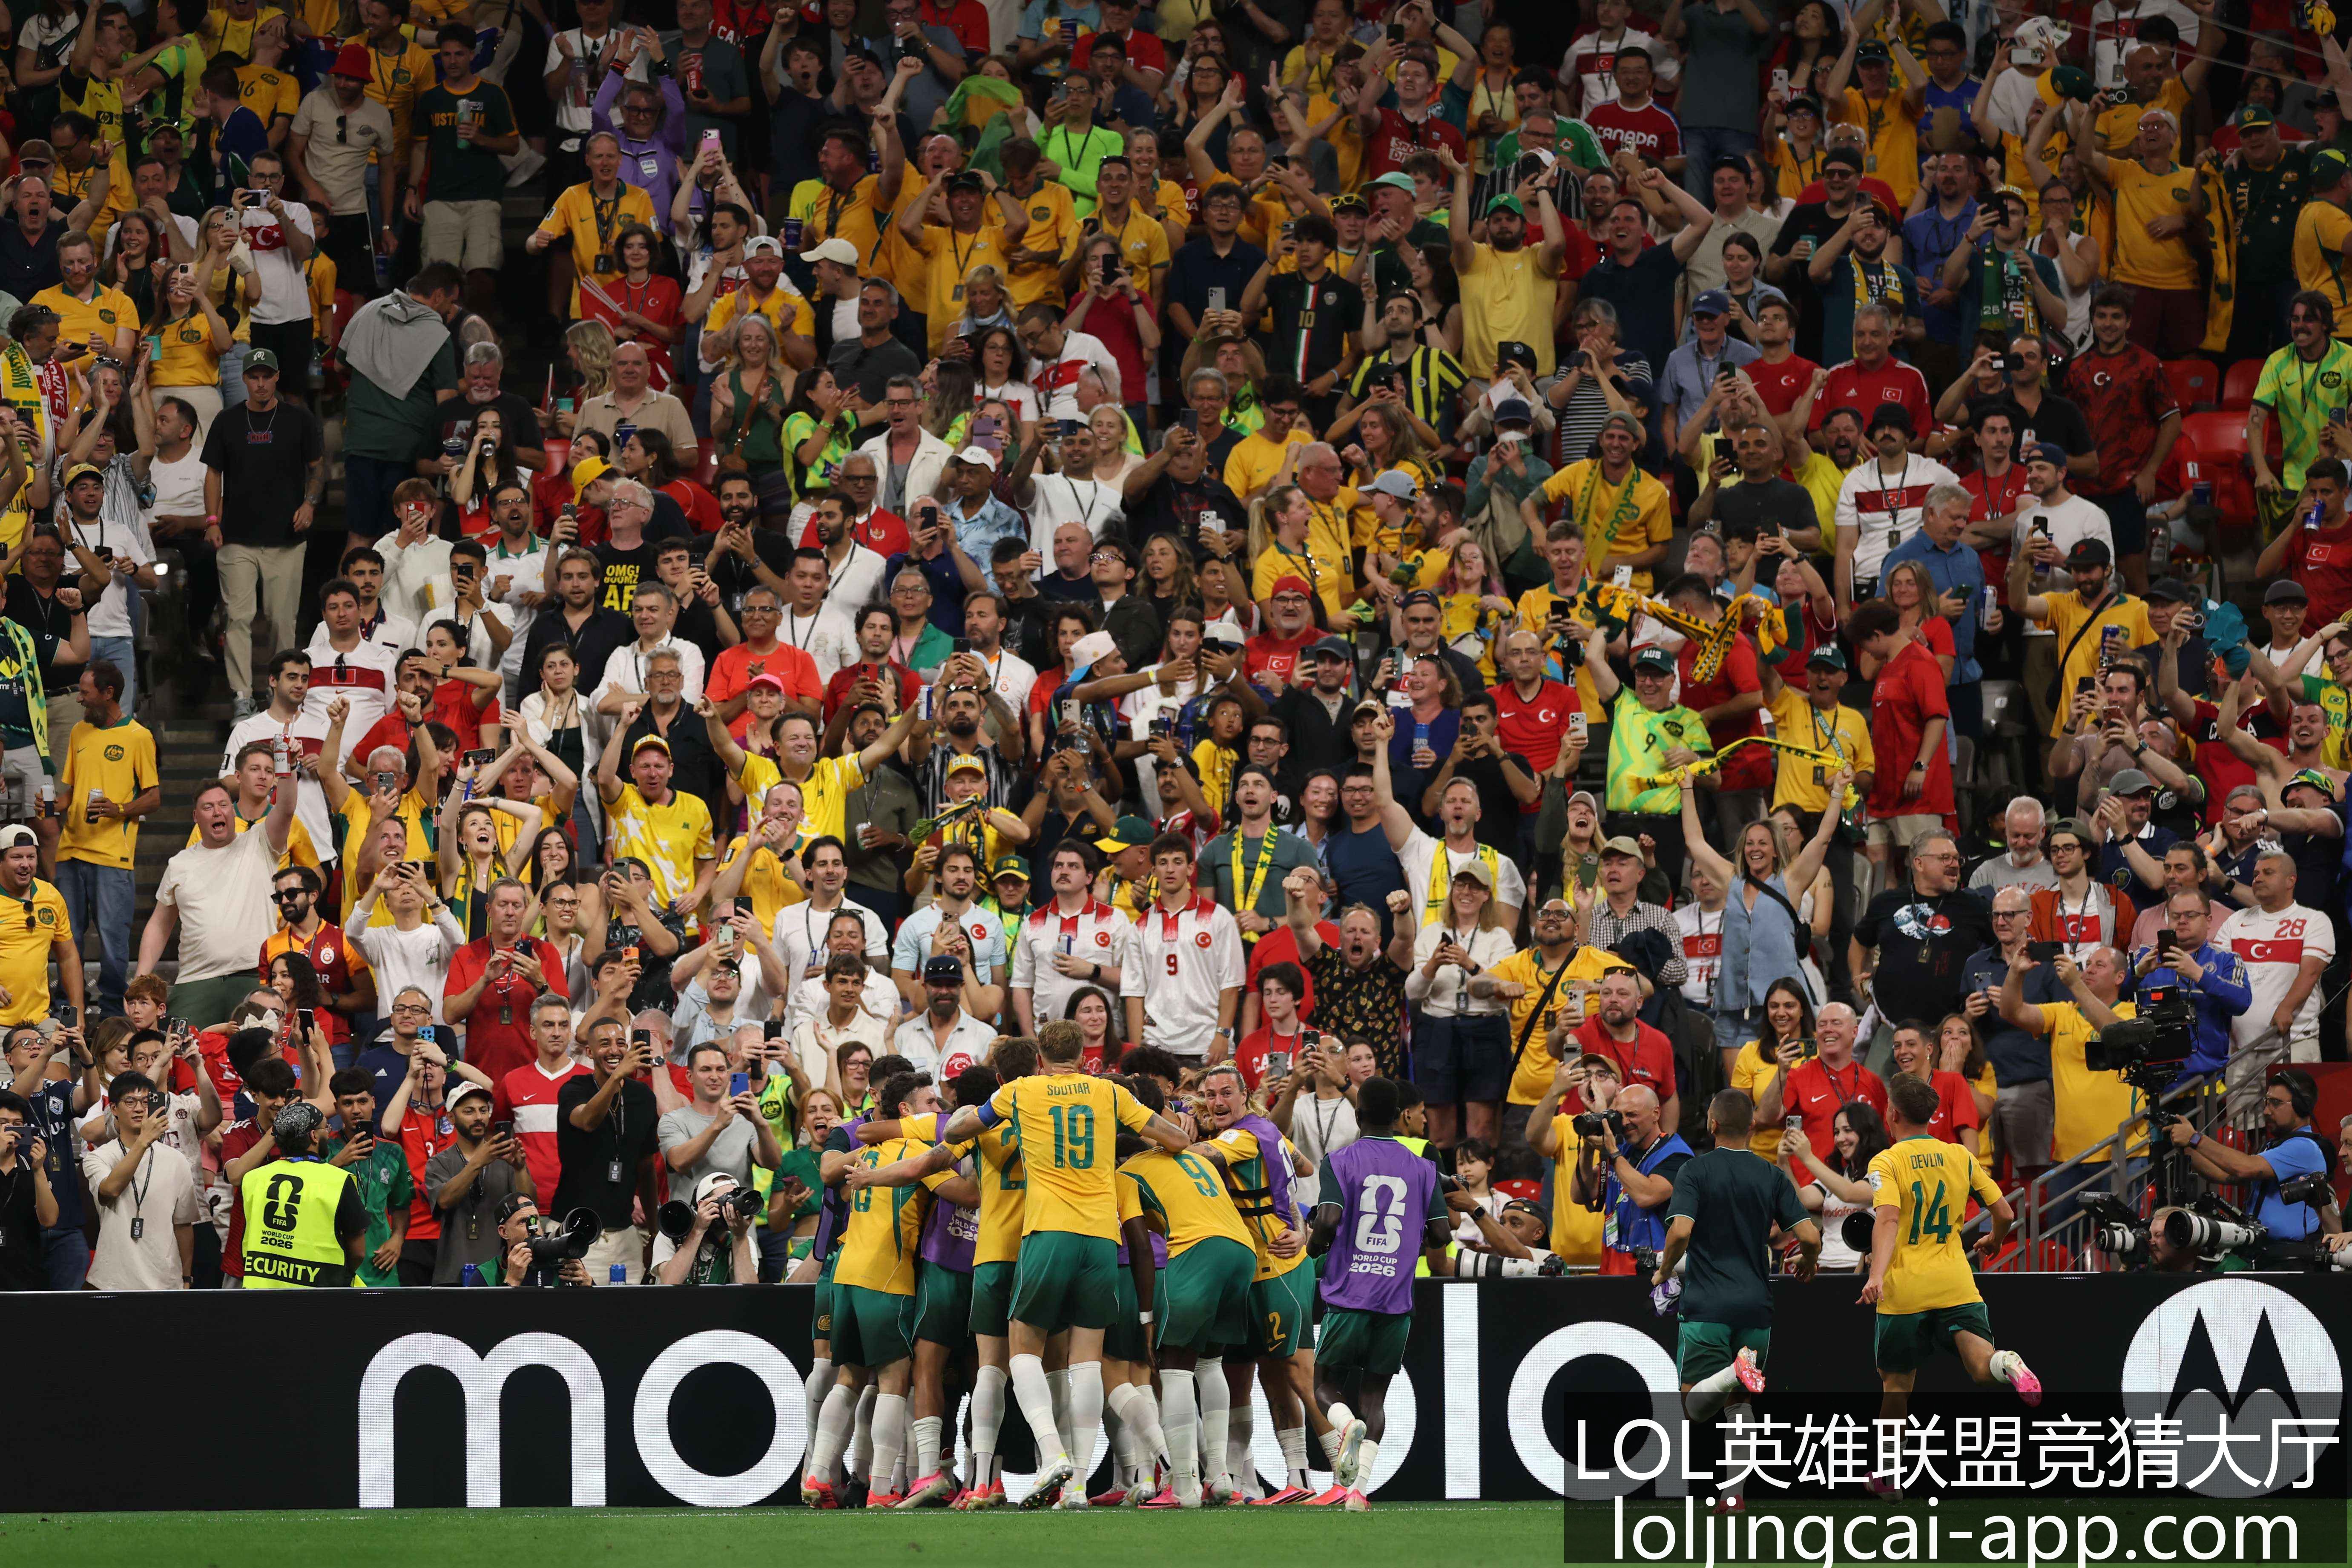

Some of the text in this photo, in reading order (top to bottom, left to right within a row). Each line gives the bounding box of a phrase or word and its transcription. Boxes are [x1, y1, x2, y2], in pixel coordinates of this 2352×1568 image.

[1597, 126, 1658, 148] CANADA
[1298, 310, 1316, 327] 10
[606, 565, 640, 576] OMG!
[1642, 649, 1662, 659] AUS
[1813, 646, 1833, 656] AUS
[1644, 733, 1657, 753] 9
[951, 755, 981, 768] AUS
[2274, 918, 2307, 938] 28
[1166, 953, 1177, 975] 9
[1047, 1082, 1091, 1097] SOUTTAR
[1047, 1105, 1095, 1169] 19
[1910, 1152, 1944, 1169] DEVLIN
[1174, 1153, 1218, 1198] 9
[1905, 1178, 1953, 1246] 14
[272, 1218, 287, 1228] FIFA
[262, 1229, 295, 1241] WORLD CUP
[1365, 1236, 1386, 1246] FIFA
[260, 1237, 293, 1250] 2026
[1351, 1254, 1397, 1265] WORLD CUP
[244, 1256, 321, 1284] ECURITY
[1348, 1262, 1395, 1278] 2026
